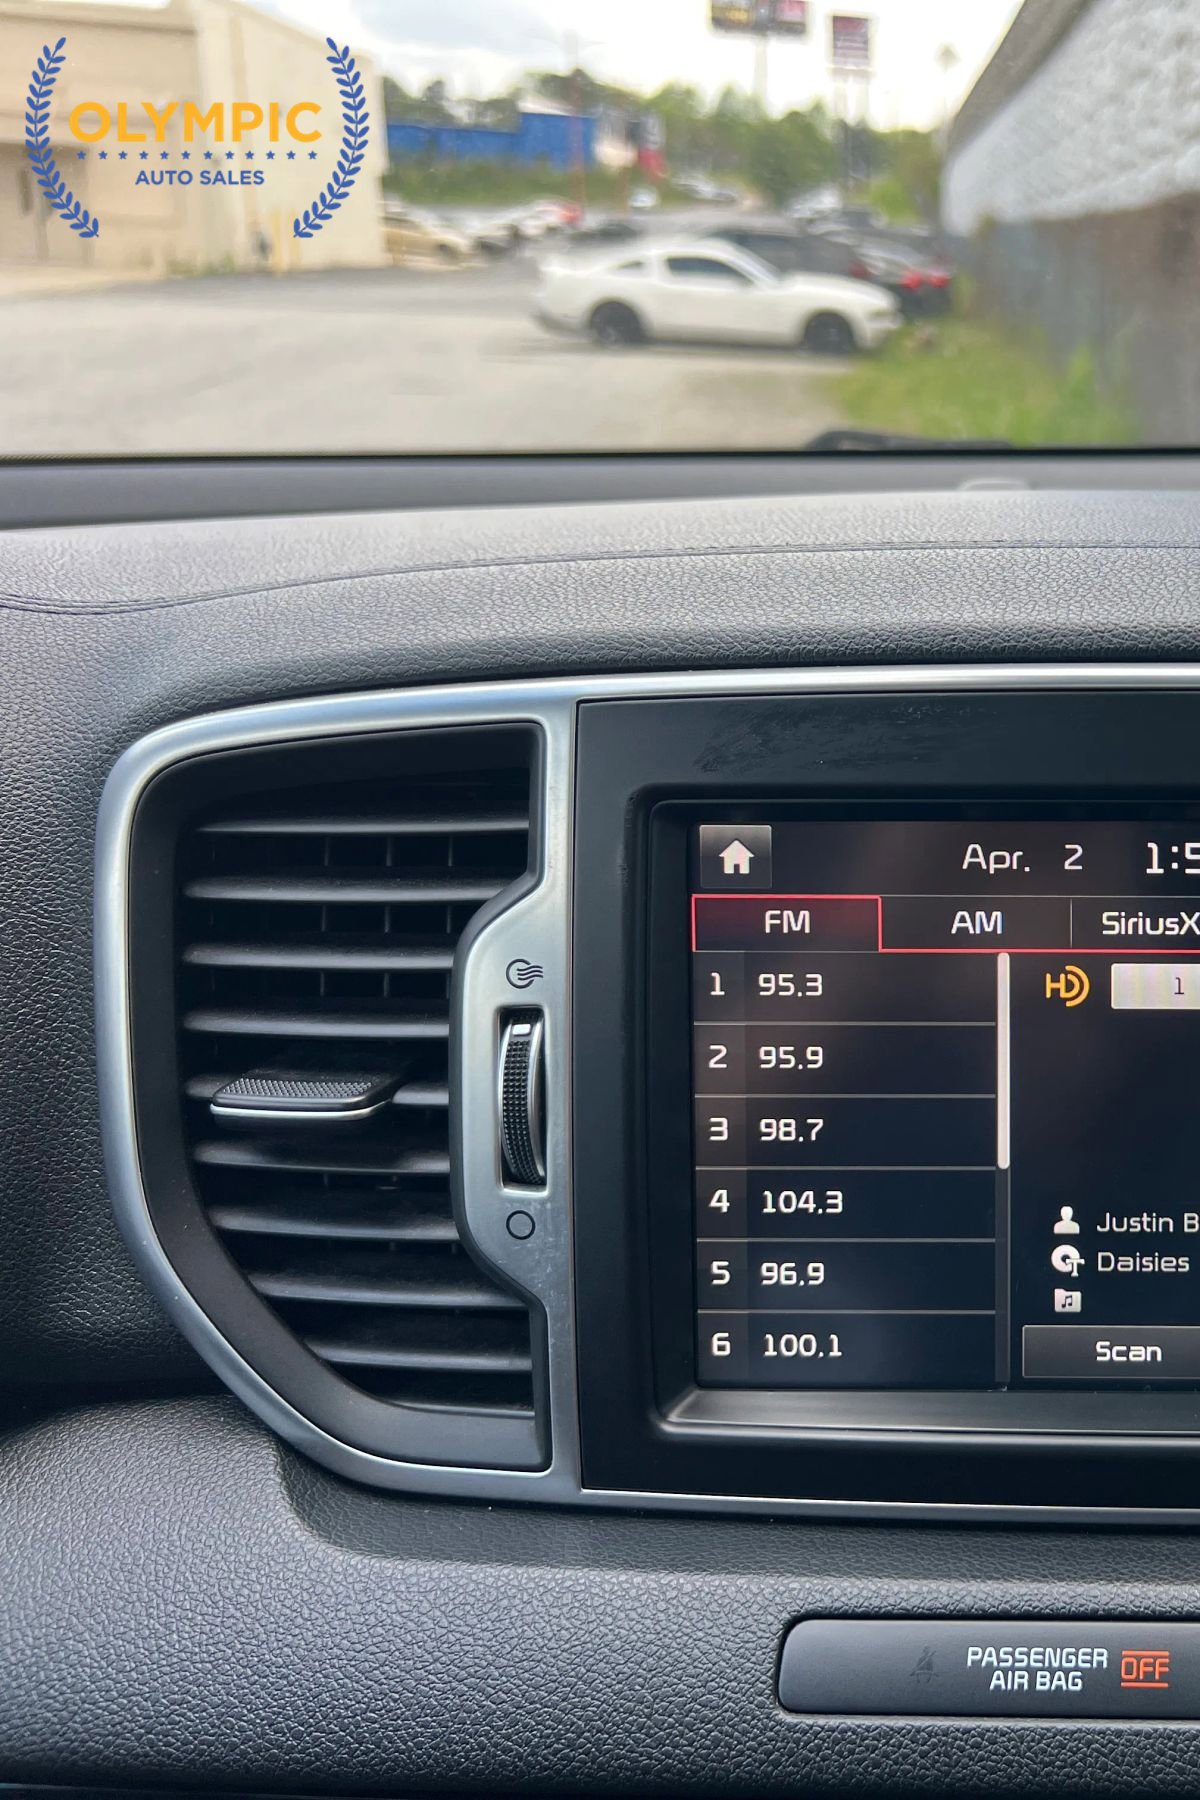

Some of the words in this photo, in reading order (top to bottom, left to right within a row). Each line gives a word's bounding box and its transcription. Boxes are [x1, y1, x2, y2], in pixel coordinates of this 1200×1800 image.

[962, 844, 1030, 874] Apr.
[1064, 844, 1083, 870] 2
[764, 910, 811, 934] FM
[951, 910, 1003, 935] AM
[710, 972, 725, 996] 1
[758, 973, 824, 997] 95.3
[1173, 976, 1185, 996] 1
[708, 1045, 728, 1069] 2
[759, 1046, 824, 1070] 95.9
[709, 1117, 729, 1141] 3
[759, 1118, 825, 1143] 98.7
[709, 1189, 730, 1213] 4
[762, 1190, 844, 1215] 104.3
[1096, 1212, 1174, 1233] Justin
[711, 1261, 731, 1285] 5
[760, 1262, 825, 1287] 96.9
[1097, 1252, 1190, 1272] Daisies
[712, 1332, 731, 1356] 6
[763, 1333, 843, 1359] 100.1
[1095, 1341, 1163, 1364] Scan
[966, 1646, 1109, 1669] PASSENGER
[1120, 1657, 1170, 1680] OFF
[989, 1670, 1029, 1691] AIR
[1035, 1670, 1083, 1691] BAG
